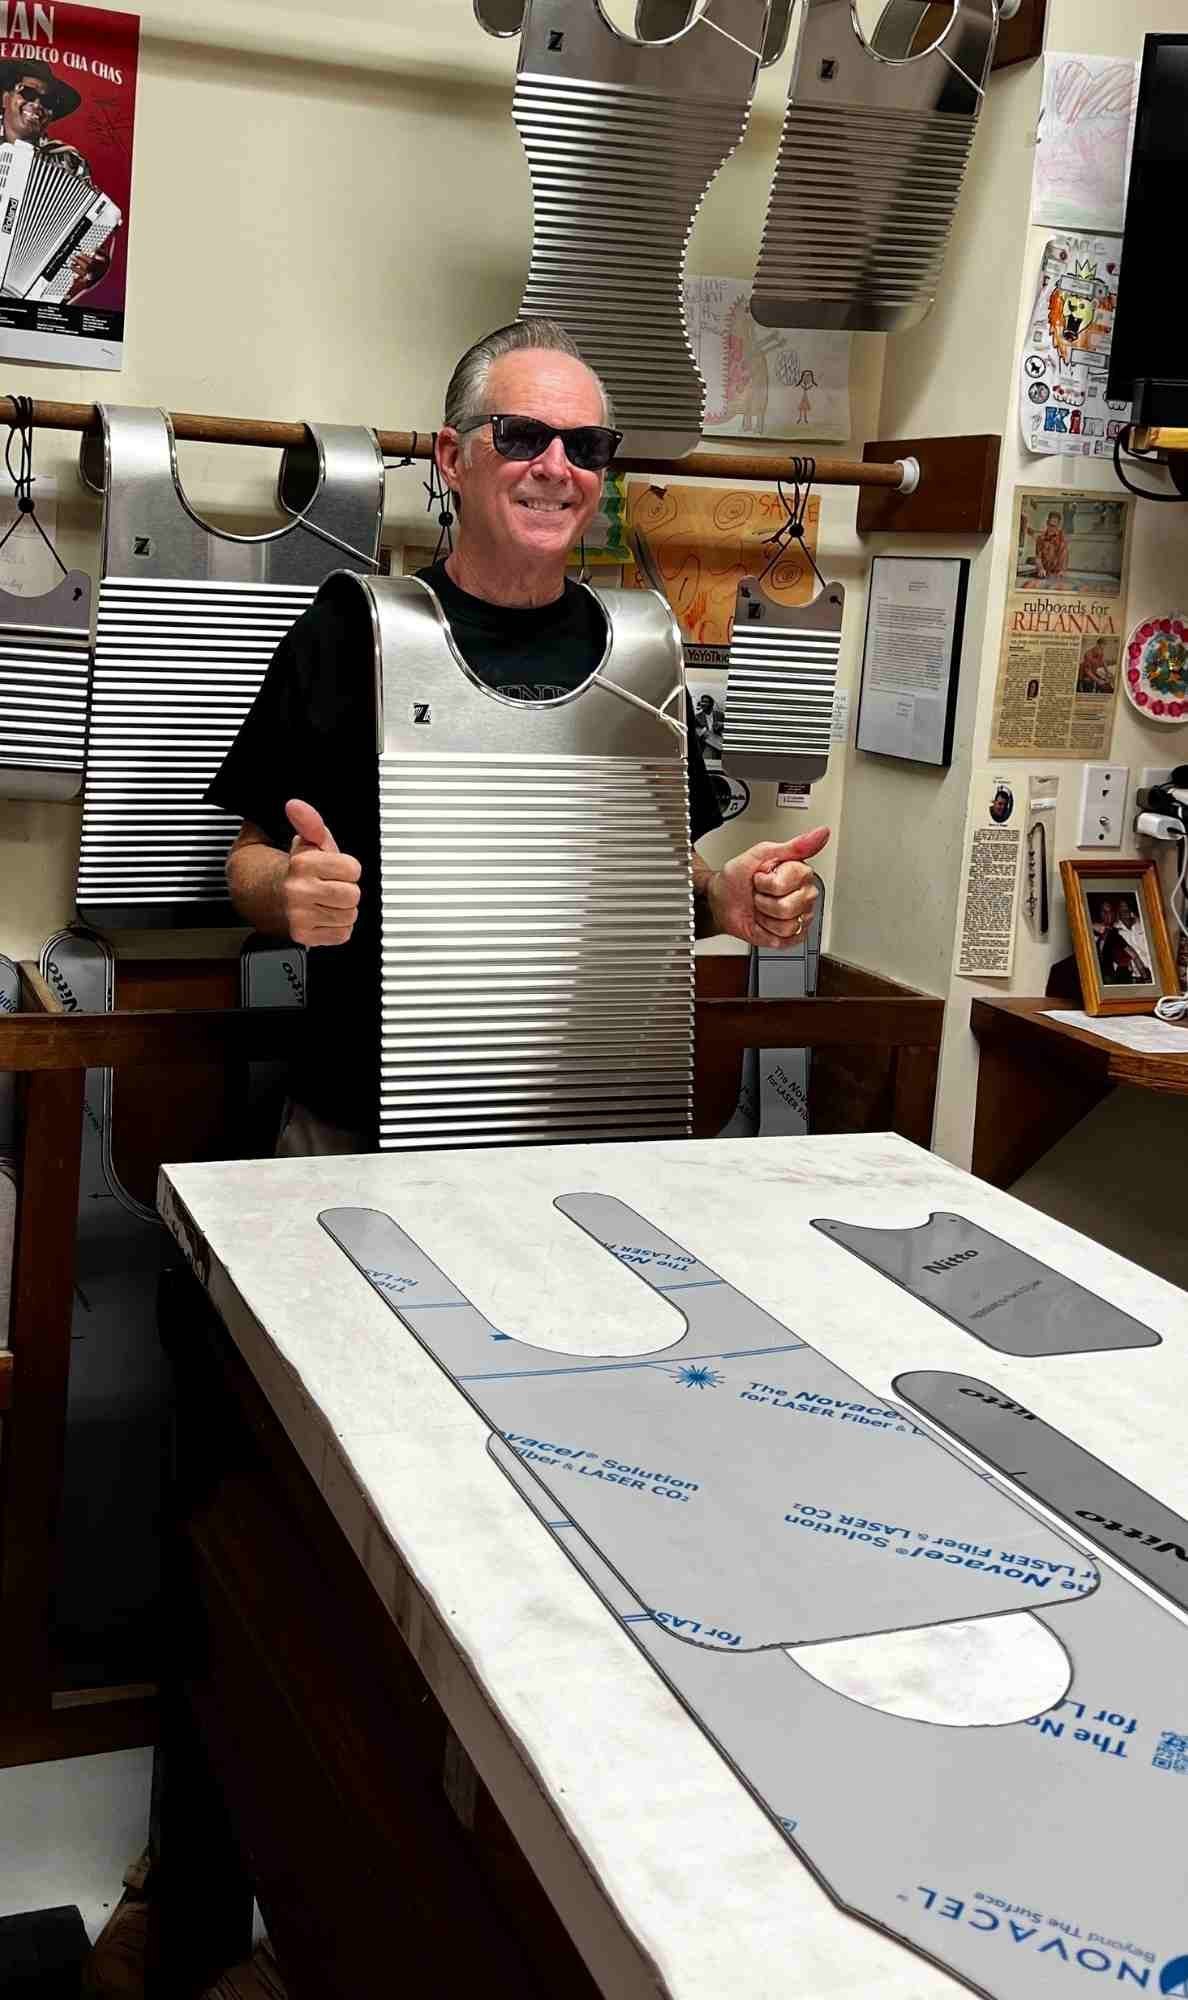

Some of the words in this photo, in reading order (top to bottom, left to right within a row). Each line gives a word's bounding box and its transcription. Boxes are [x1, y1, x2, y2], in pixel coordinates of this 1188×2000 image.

[11, 43, 59, 64] ZYDECO
[63, 51, 88, 71] CHA
[92, 60, 122, 85] CHAS
[2, 199, 17, 233] Roland
[1023, 598, 1087, 615] rubboards
[1091, 602, 1112, 616] for
[1012, 611, 1116, 634] RIHANNA
[776, 1086, 798, 1110] LASER
[620, 1246, 671, 1261] LASER
[921, 1249, 979, 1276] Nitto
[657, 1261, 688, 1272] The
[749, 1382, 788, 1397] The
[739, 1391, 770, 1402] for
[772, 1399, 835, 1418] LASER
[840, 1412, 892, 1429] Fiber
[578, 1465, 647, 1490] LASER
[601, 1458, 699, 1492] Solution
[784, 1515, 890, 1548] Solution
[838, 1514, 911, 1539] LASER
[931, 1536, 993, 1558] Fiber
[1000, 1551, 1076, 1578] LASER
[704, 1629, 742, 1647] for
[1093, 1711, 1137, 1735] for
[1074, 1728, 1128, 1759] The
[973, 1890, 1044, 1924] Surface
[916, 1886, 1152, 1989] NOVACEL
[1047, 1918, 1083, 1939] The
[1088, 1932, 1156, 1964] Beyond
